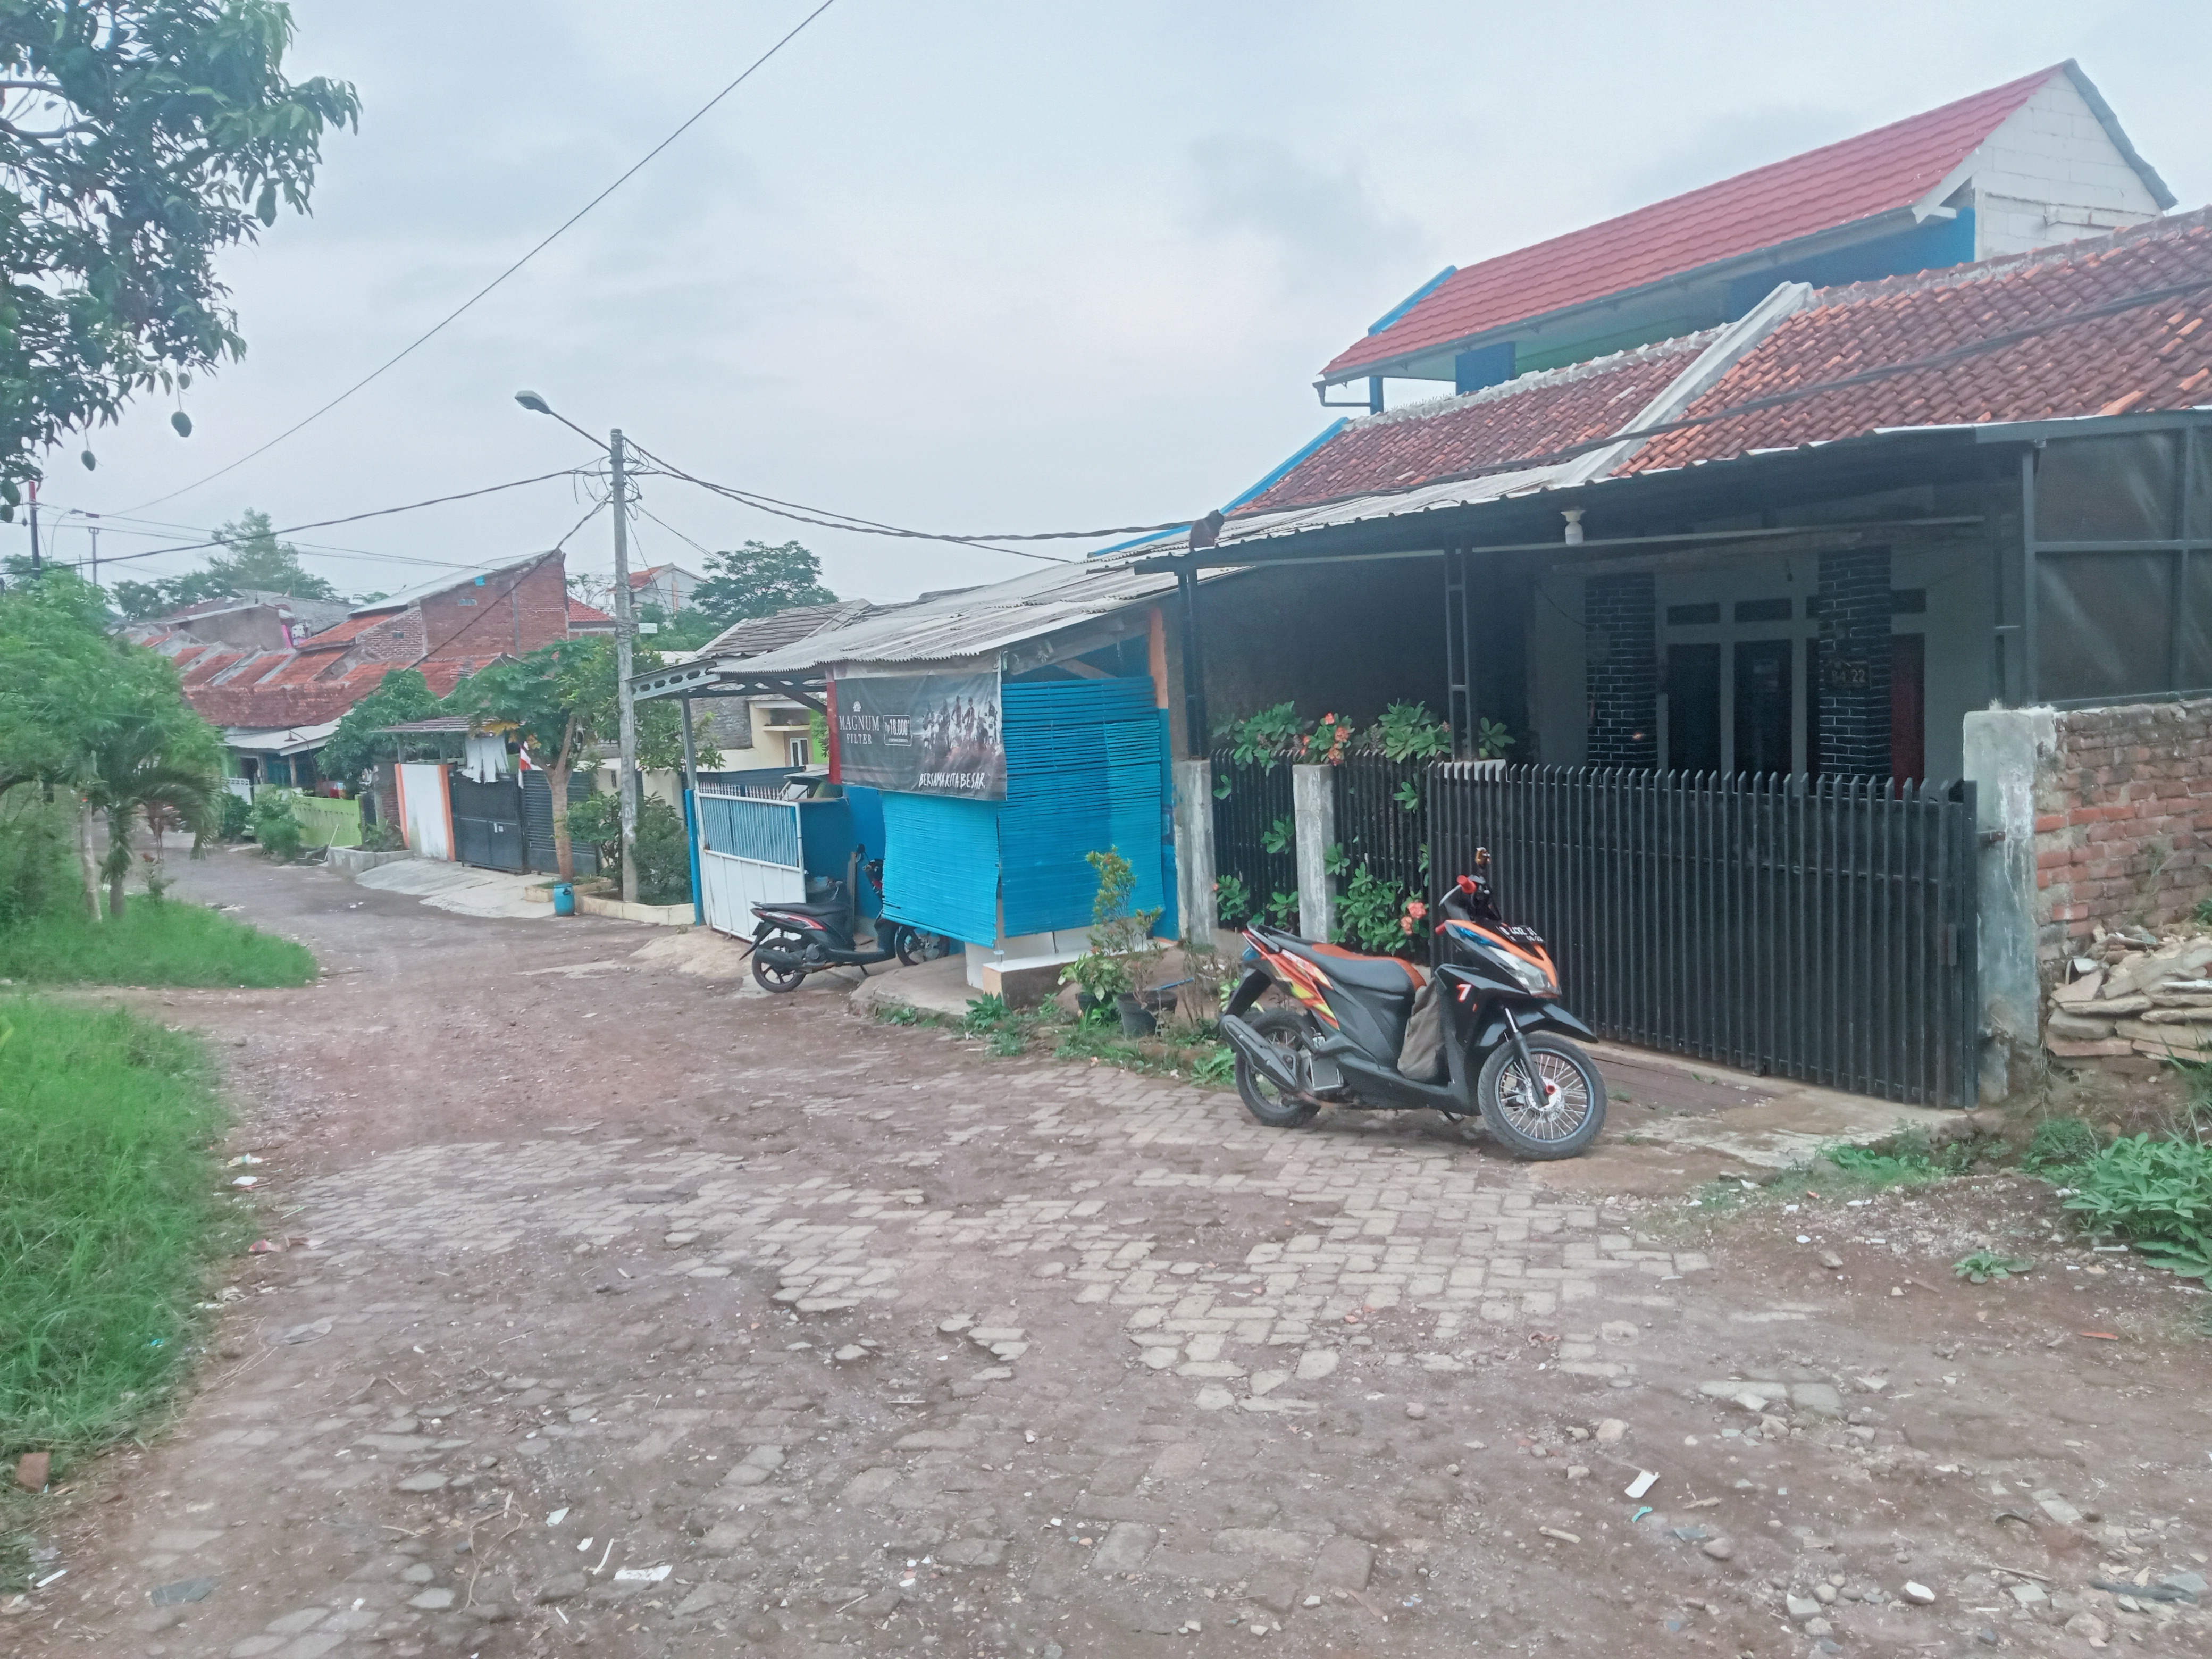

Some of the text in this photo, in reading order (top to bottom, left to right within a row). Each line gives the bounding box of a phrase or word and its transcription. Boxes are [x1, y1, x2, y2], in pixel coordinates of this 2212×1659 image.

[1851, 669, 1866, 683] 22
[839, 715, 879, 731] MAGNUM
[847, 733, 872, 745] FILTER
[918, 772, 945, 788] BERSAMA
[1456, 983, 1472, 1003] 7
